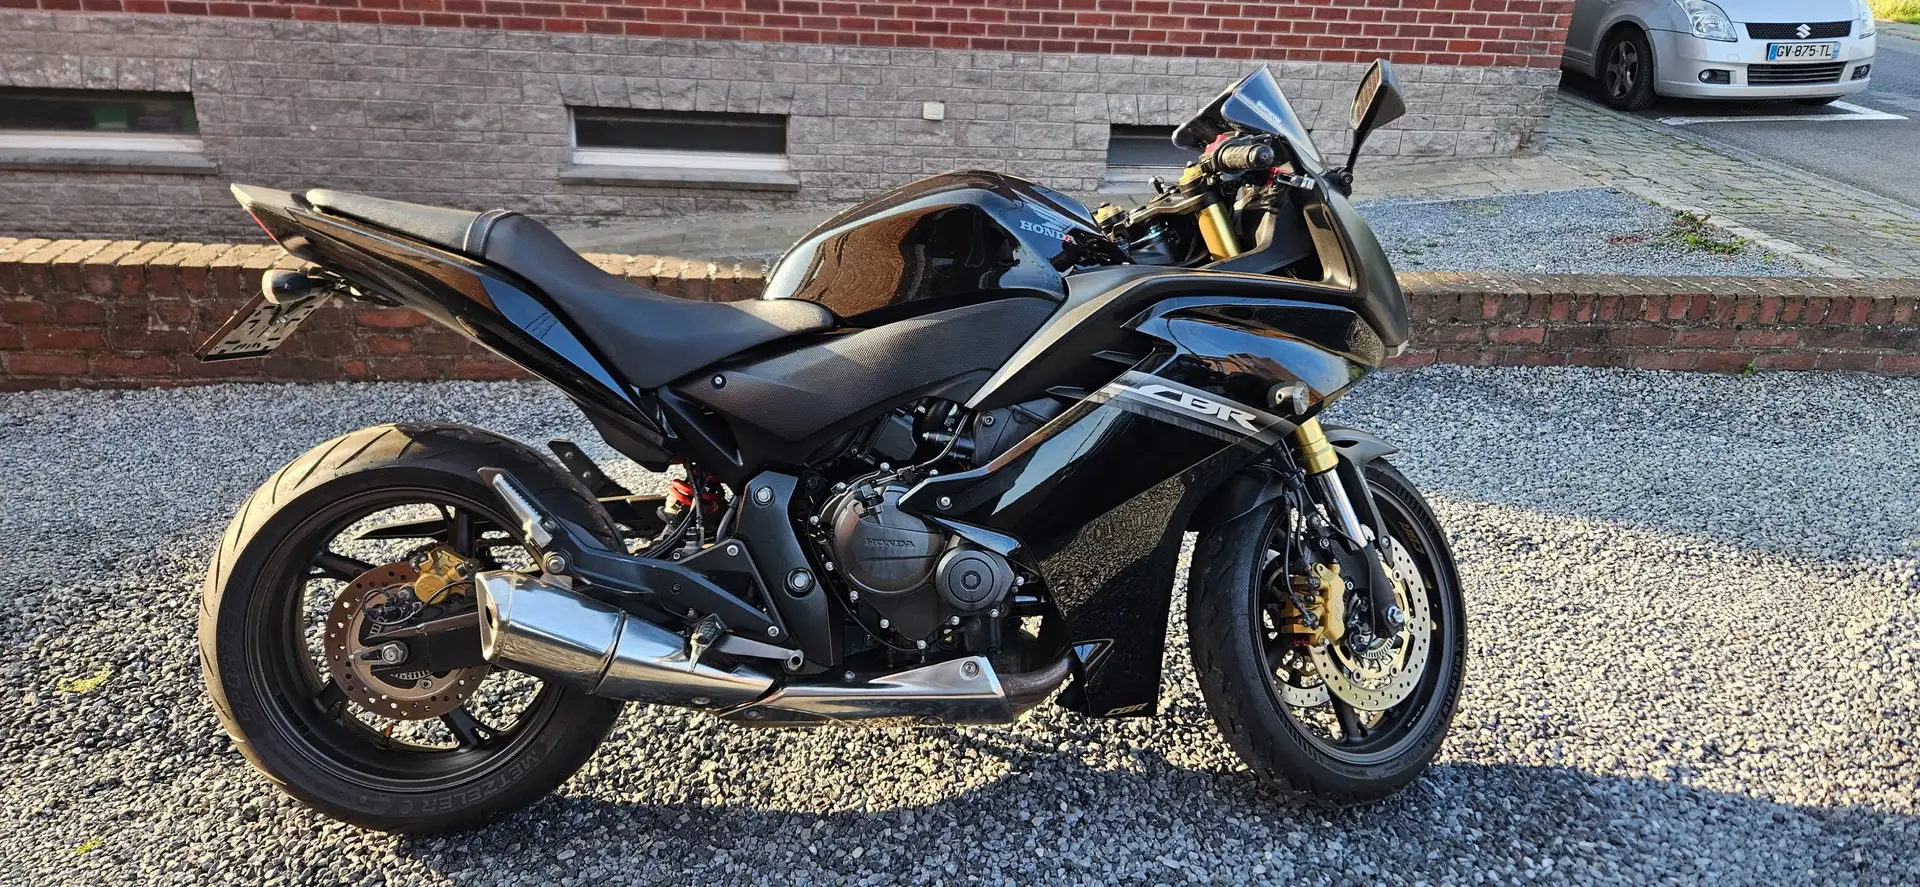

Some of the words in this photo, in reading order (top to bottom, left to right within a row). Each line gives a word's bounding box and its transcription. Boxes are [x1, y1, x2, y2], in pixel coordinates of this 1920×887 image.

[1776, 44, 1832, 57] GV-875-TL
[1020, 220, 1078, 245] HONDA
[1139, 384, 1260, 433] CBR
[864, 537, 916, 548] HONDA
[421, 750, 540, 813] METZELER
